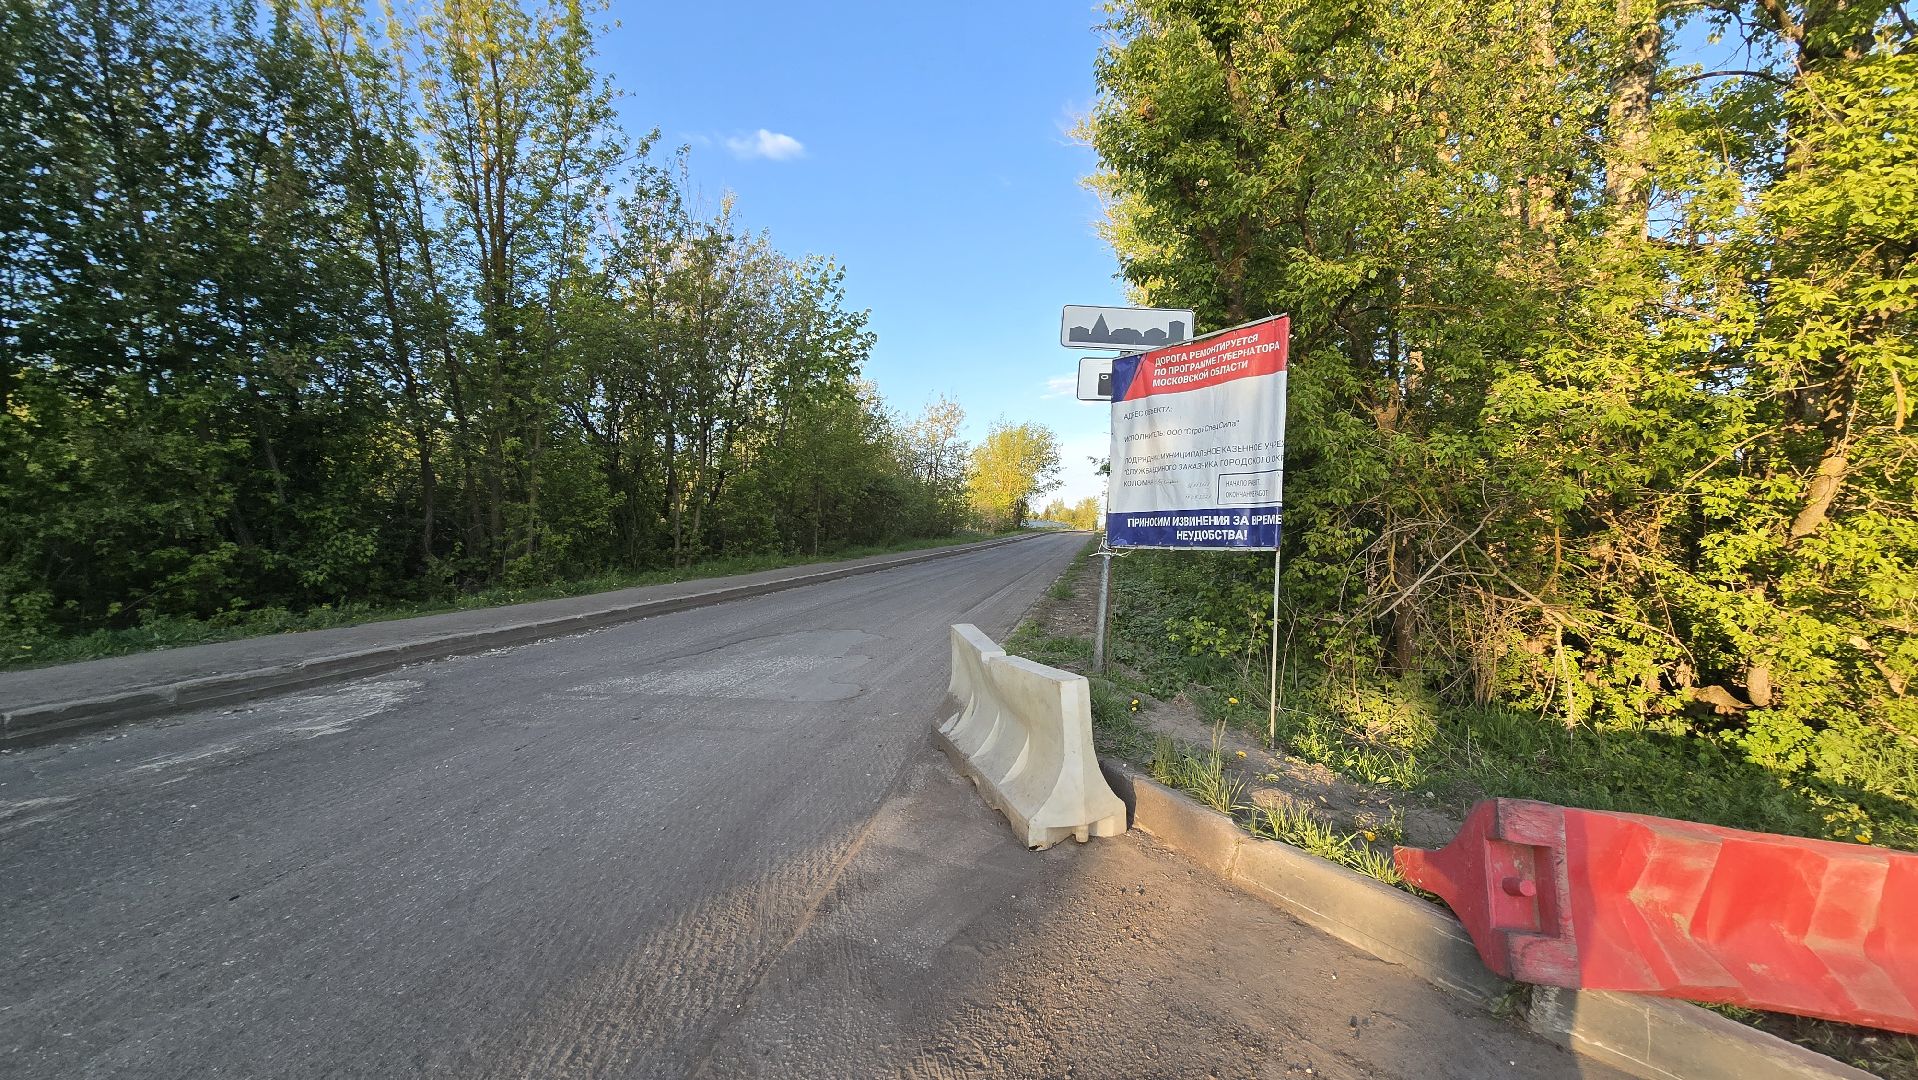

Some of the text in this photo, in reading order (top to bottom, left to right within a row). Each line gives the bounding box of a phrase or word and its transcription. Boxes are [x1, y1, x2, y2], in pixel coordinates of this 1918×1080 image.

[1155, 333, 1259, 367] ДОРОГА РЕМОНТИРУЕТСЯ
[1153, 341, 1280, 377] ПО ПРОГРАММЕ ГУБЕРНАТОРА
[1152, 360, 1248, 387] МОСКОВСКОЙ ОБЛАСТИ
[1124, 410, 1144, 420] АДРЕС
[1264, 439, 1285, 450] УЧРЕ
[1127, 514, 1283, 528] ПРИНОСИМ ИЗВИНЕНИЯ ЗА ВРЕМЕ
[1176, 529, 1248, 541] НЕУДОБСТВА!
